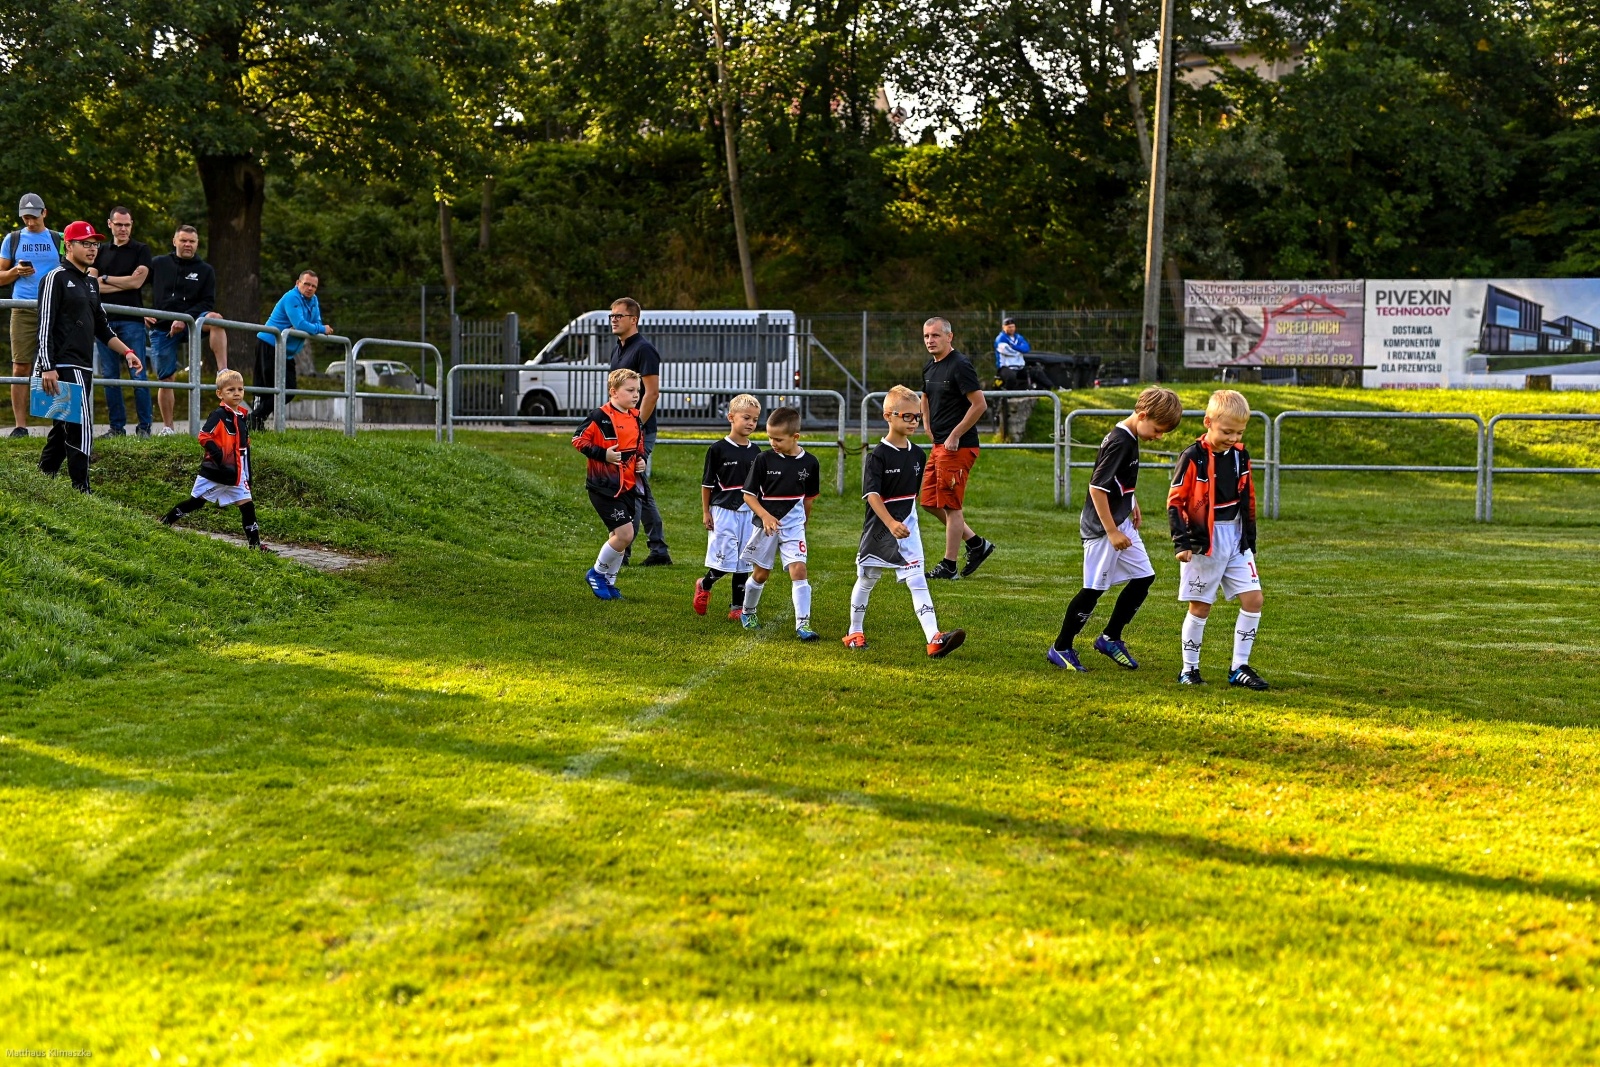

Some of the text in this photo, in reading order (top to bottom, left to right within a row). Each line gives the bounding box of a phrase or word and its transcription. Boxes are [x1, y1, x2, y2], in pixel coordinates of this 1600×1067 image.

[22, 243, 52, 252] BIG STAR
[1229, 284, 1291, 294] CIESIELSKO
[1299, 283, 1361, 294] DEKARSKIE
[1222, 295, 1246, 305] POD
[1375, 290, 1452, 306] PIVEXIN
[1375, 306, 1451, 316] TECHNOLOGY
[1392, 325, 1433, 335] DOSTAWCA
[1383, 337, 1442, 348] KOMPONENTÓW
[1262, 353, 1354, 366] tel. 698 650 692
[1387, 349, 1437, 361] I ROZWIĄZAŃ
[1381, 363, 1443, 373] DLA PRZEMYSŁU
[798, 540, 807, 553] 6
